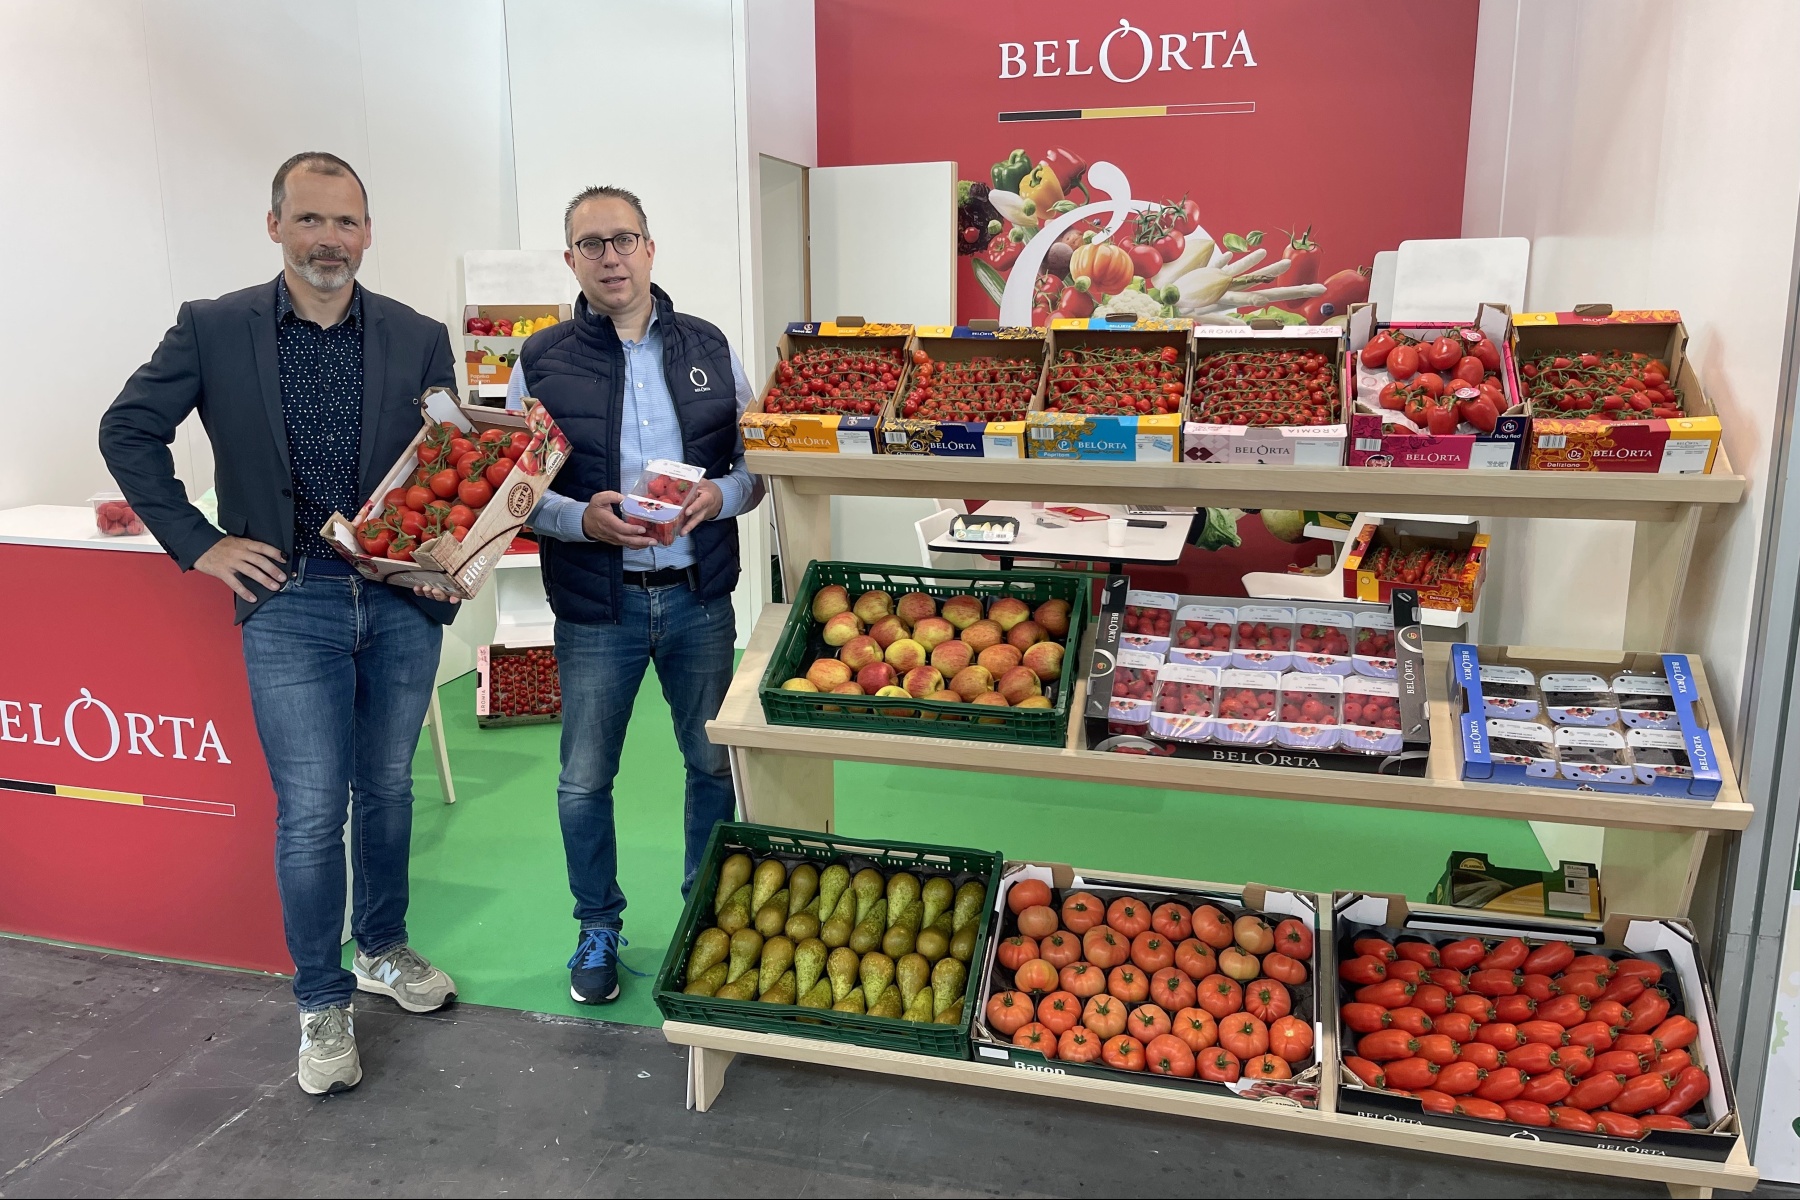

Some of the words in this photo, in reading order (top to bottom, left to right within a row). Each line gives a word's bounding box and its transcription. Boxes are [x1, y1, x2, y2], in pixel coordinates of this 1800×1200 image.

[998, 18, 1258, 84] BELORTA
[786, 436, 831, 446] BELORTA
[930, 441, 977, 450] BELORTA
[1078, 440, 1128, 450] BELORTA
[1235, 444, 1290, 455] BELORTA
[1405, 452, 1461, 463] BELORTA
[1592, 448, 1653, 459] BELORTA
[513, 485, 529, 514] TASTE
[462, 555, 488, 586] Elite
[1108, 612, 1119, 643] BELORTA
[1403, 659, 1416, 694] BELORTA
[1671, 661, 1688, 693] BELORTA
[1212, 750, 1321, 769] BELORTA
[1692, 735, 1710, 771] BELORTA
[1014, 1061, 1066, 1075] Baron
